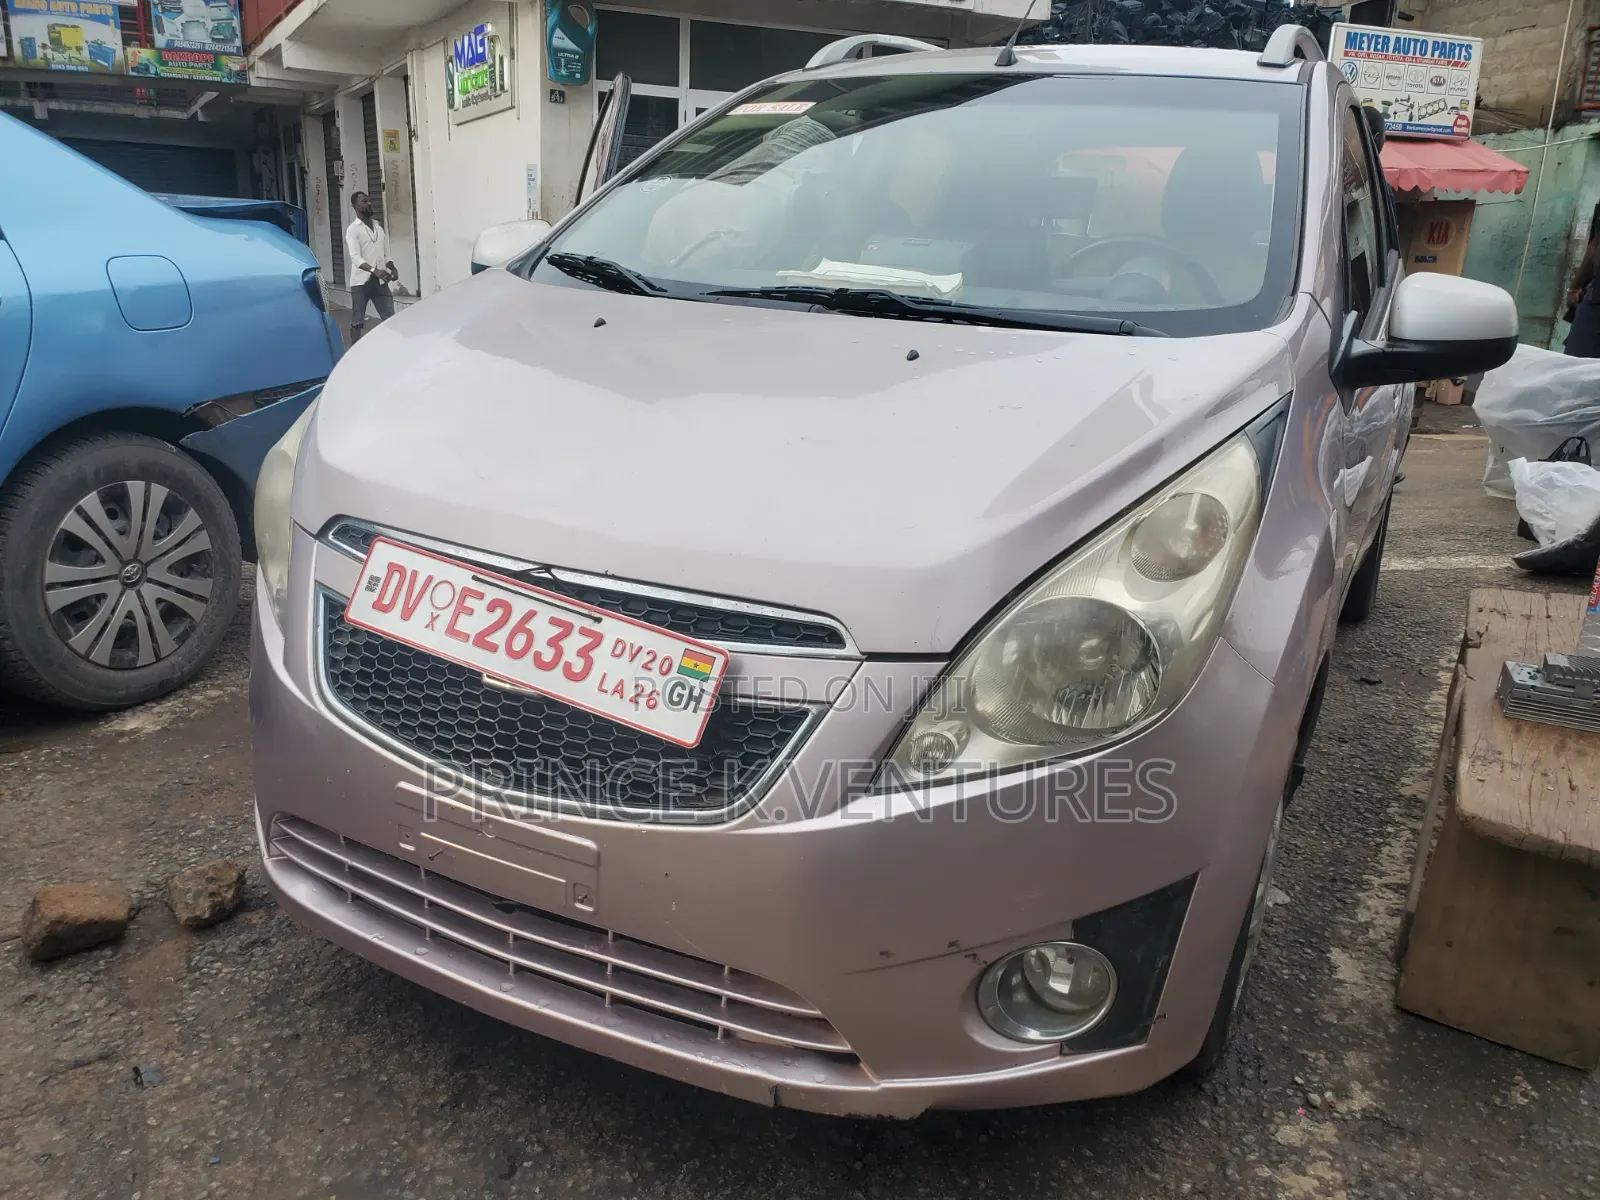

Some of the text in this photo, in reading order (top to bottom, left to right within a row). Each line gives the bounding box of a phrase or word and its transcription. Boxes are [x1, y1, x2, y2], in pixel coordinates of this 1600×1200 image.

[454, 22, 492, 73] MAG
[1345, 32, 1473, 61] MEYER AUTO PARTS
[1432, 76, 1444, 85] KIA
[767, 102, 808, 112] SALE
[1427, 221, 1449, 245] KIA
[372, 562, 604, 682] DV E2633
[424, 611, 441, 632] X
[667, 681, 705, 714] GH
